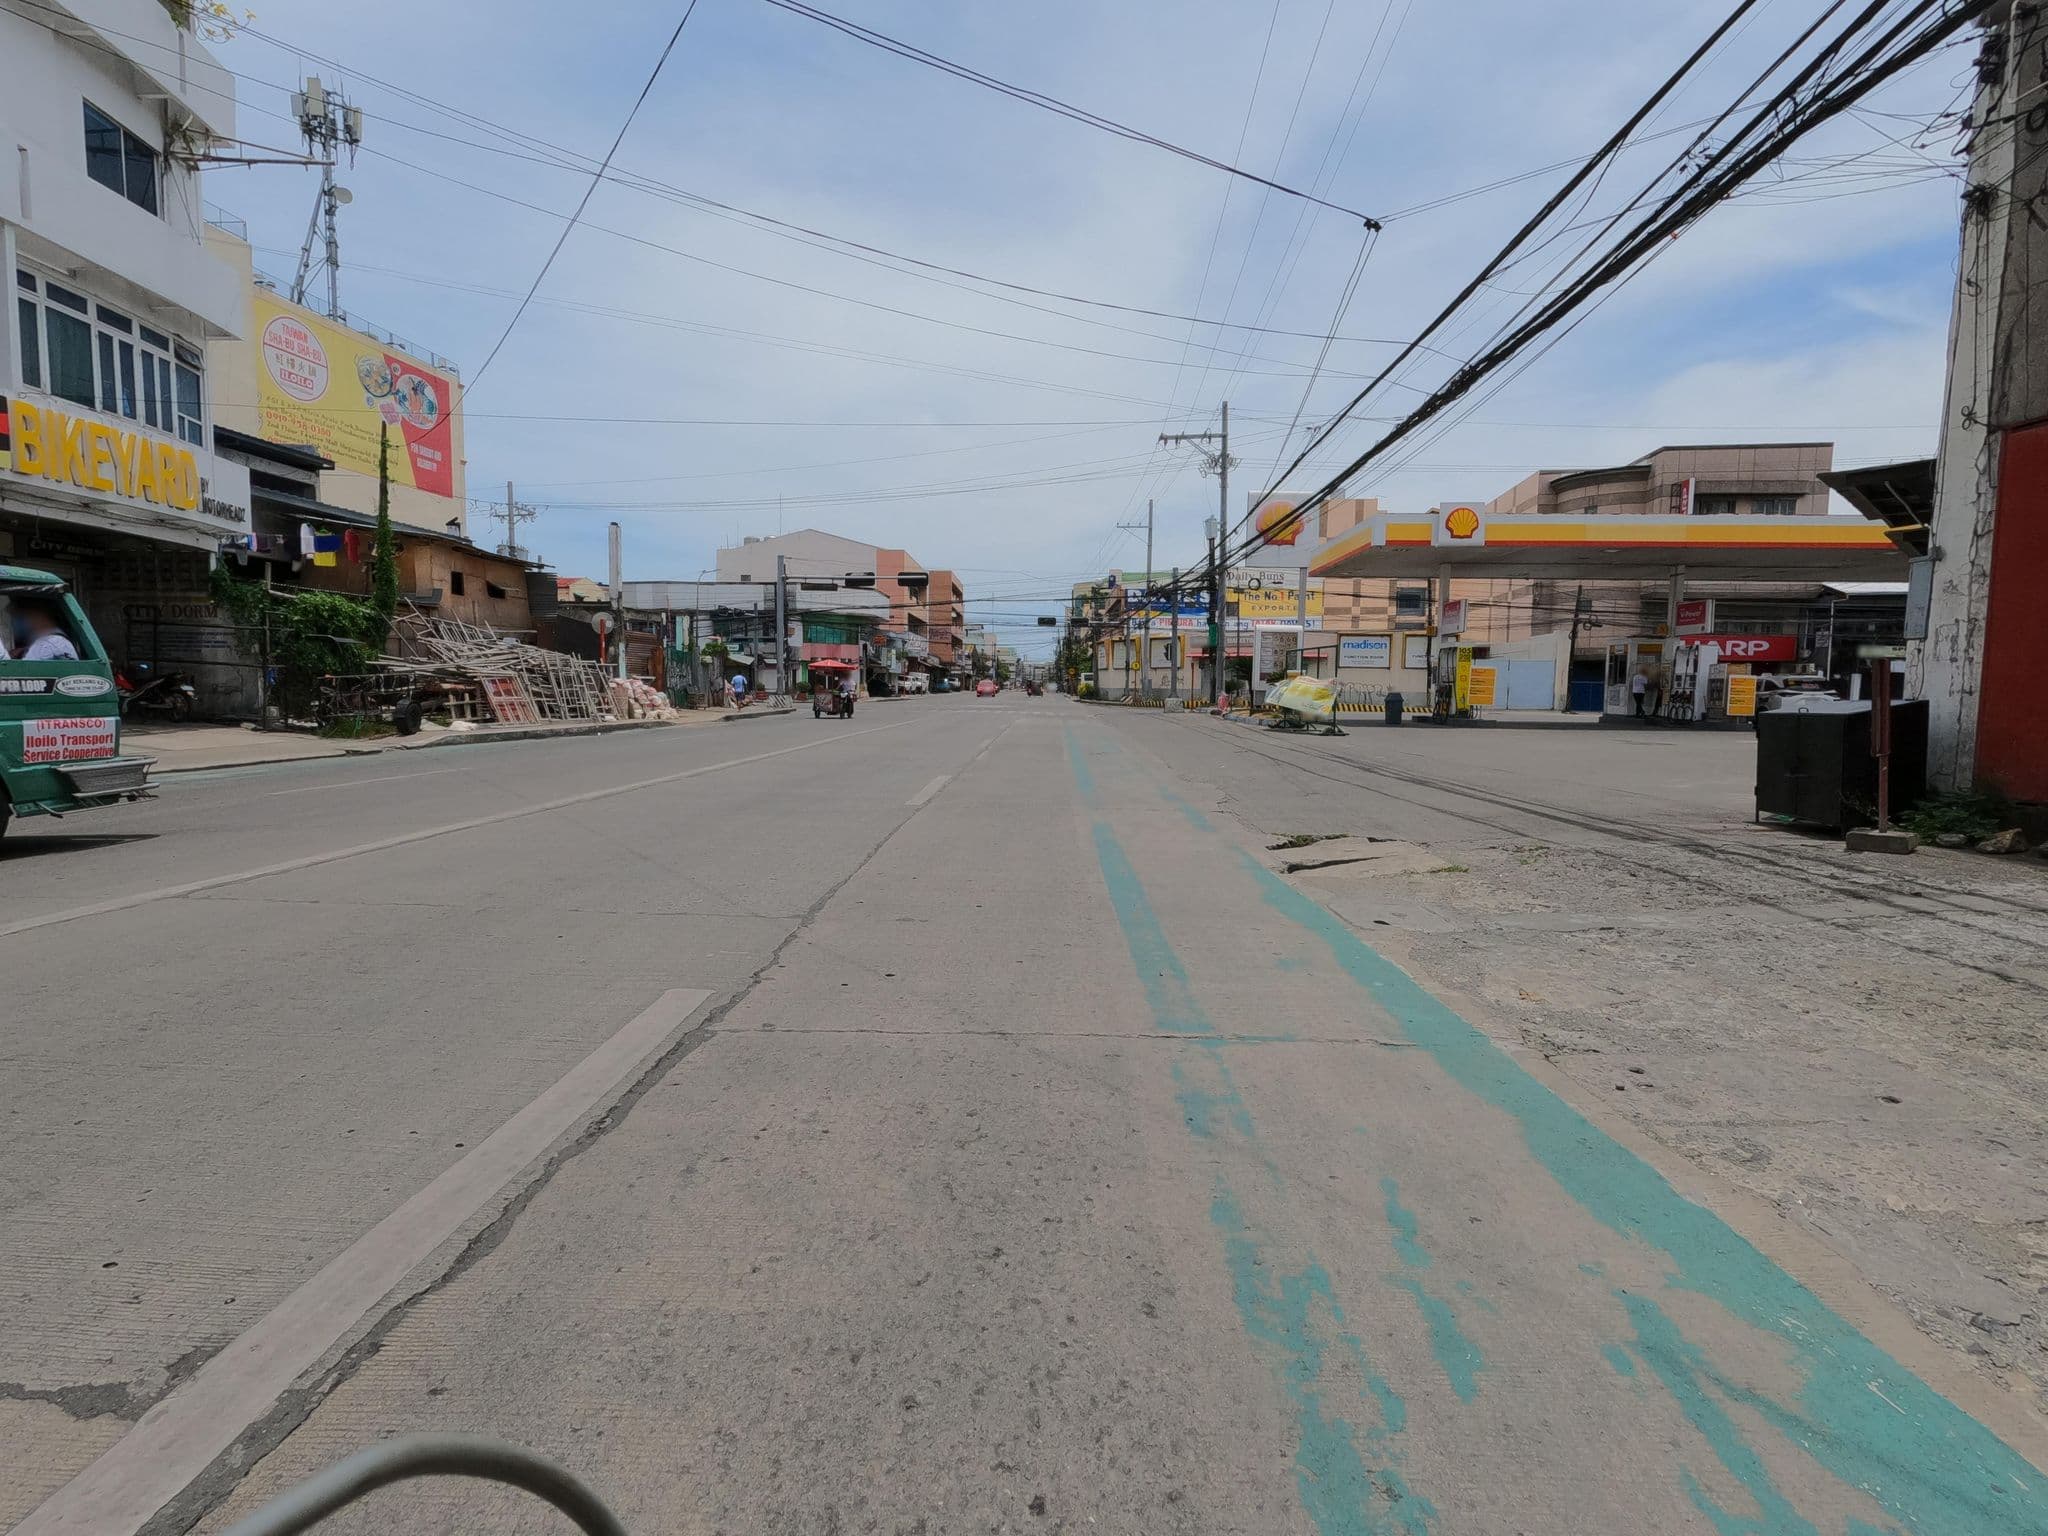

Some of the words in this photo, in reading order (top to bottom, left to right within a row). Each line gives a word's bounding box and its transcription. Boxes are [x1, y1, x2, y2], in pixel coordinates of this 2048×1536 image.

[13, 400, 201, 511] BIKEYARD
[200, 476, 210, 494] BY
[201, 496, 247, 523] MOTORHEADZ
[1244, 591, 1260, 601] The
[1287, 591, 1315, 601] Pant
[1342, 640, 1388, 649] madison
[21, 679, 47, 692] LOOP
[26, 734, 58, 748] Iloilo
[60, 733, 114, 747] Transport
[24, 748, 61, 763] Service
[62, 747, 115, 760] Cooperative
